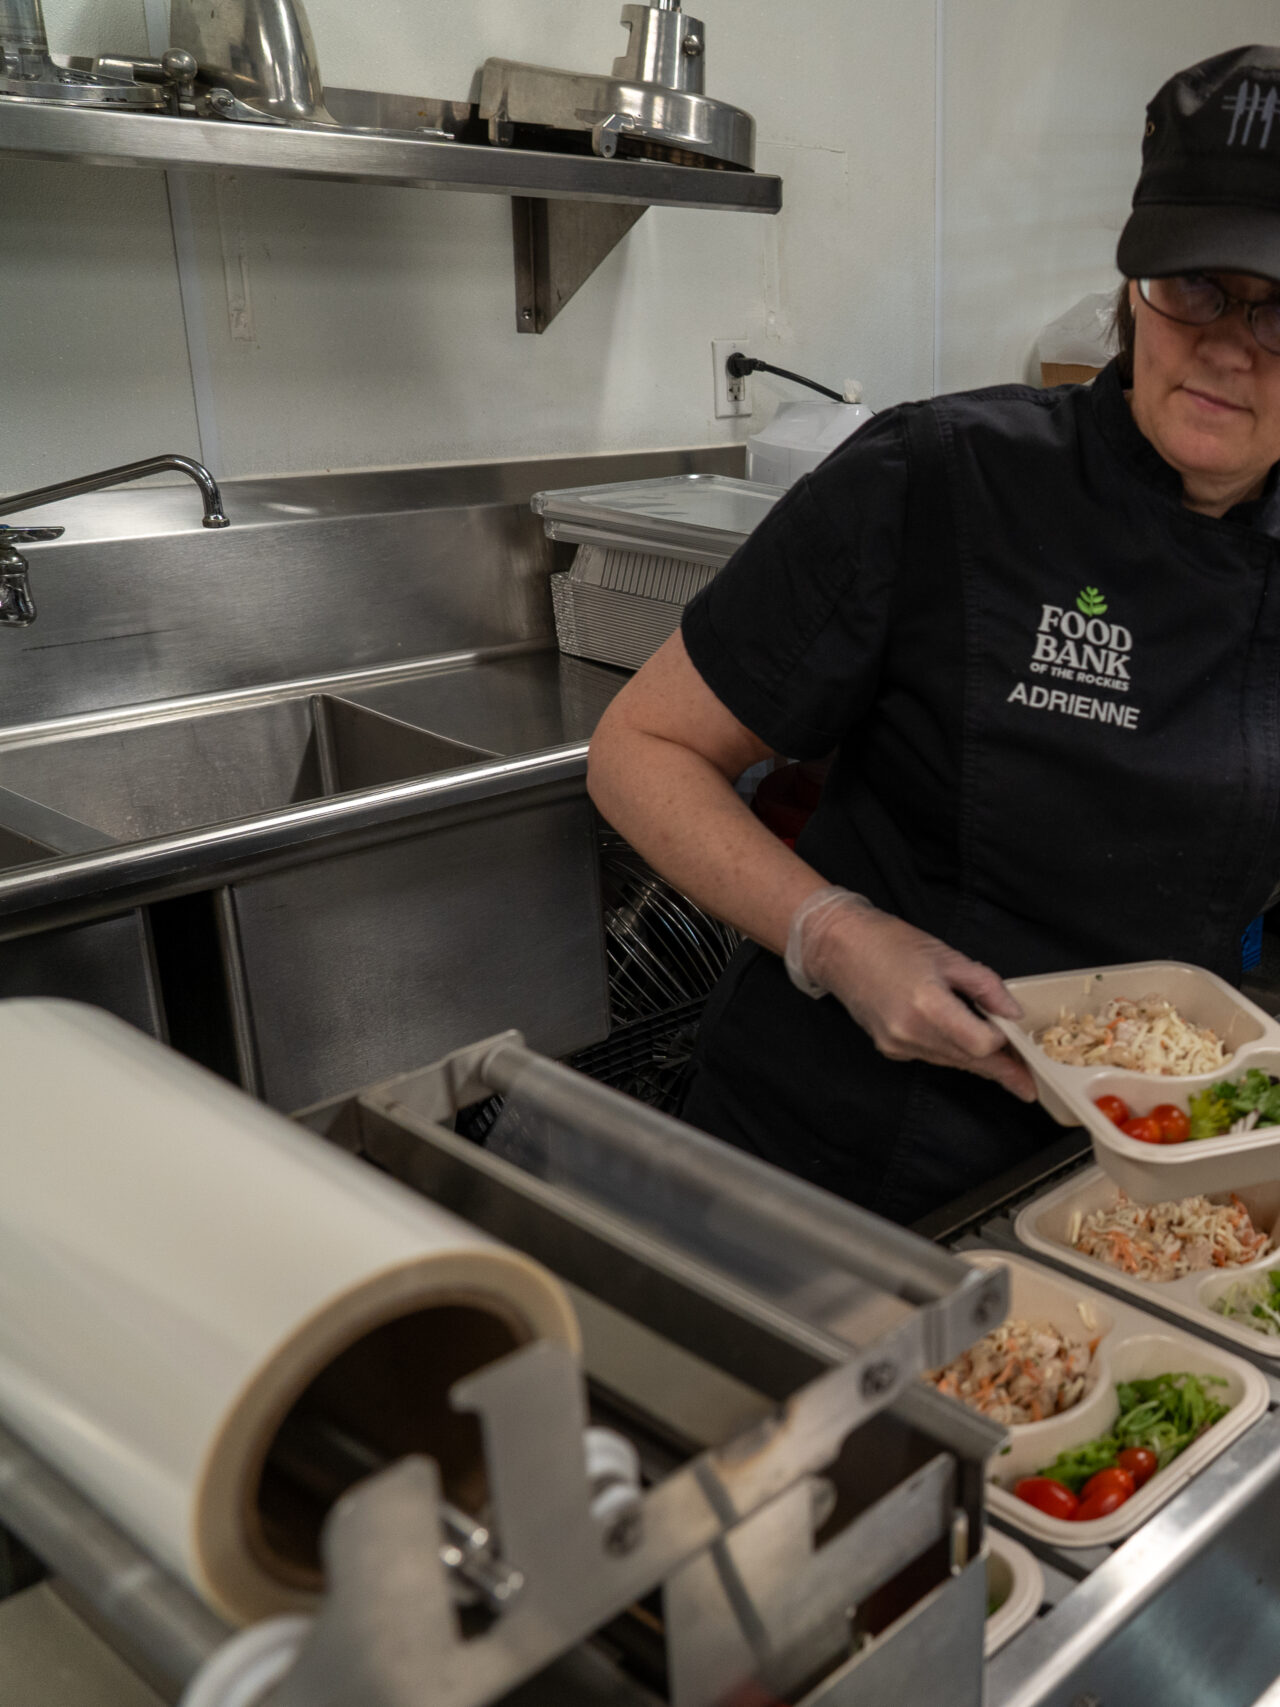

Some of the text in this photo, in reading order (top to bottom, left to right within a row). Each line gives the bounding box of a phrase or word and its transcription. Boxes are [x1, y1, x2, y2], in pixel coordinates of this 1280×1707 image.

[1038, 604, 1132, 652] FOOD
[1029, 662, 1130, 692] OF THE ROCKIES
[1032, 633, 1131, 680] BANK
[1007, 682, 1140, 730] ADRIENNE
